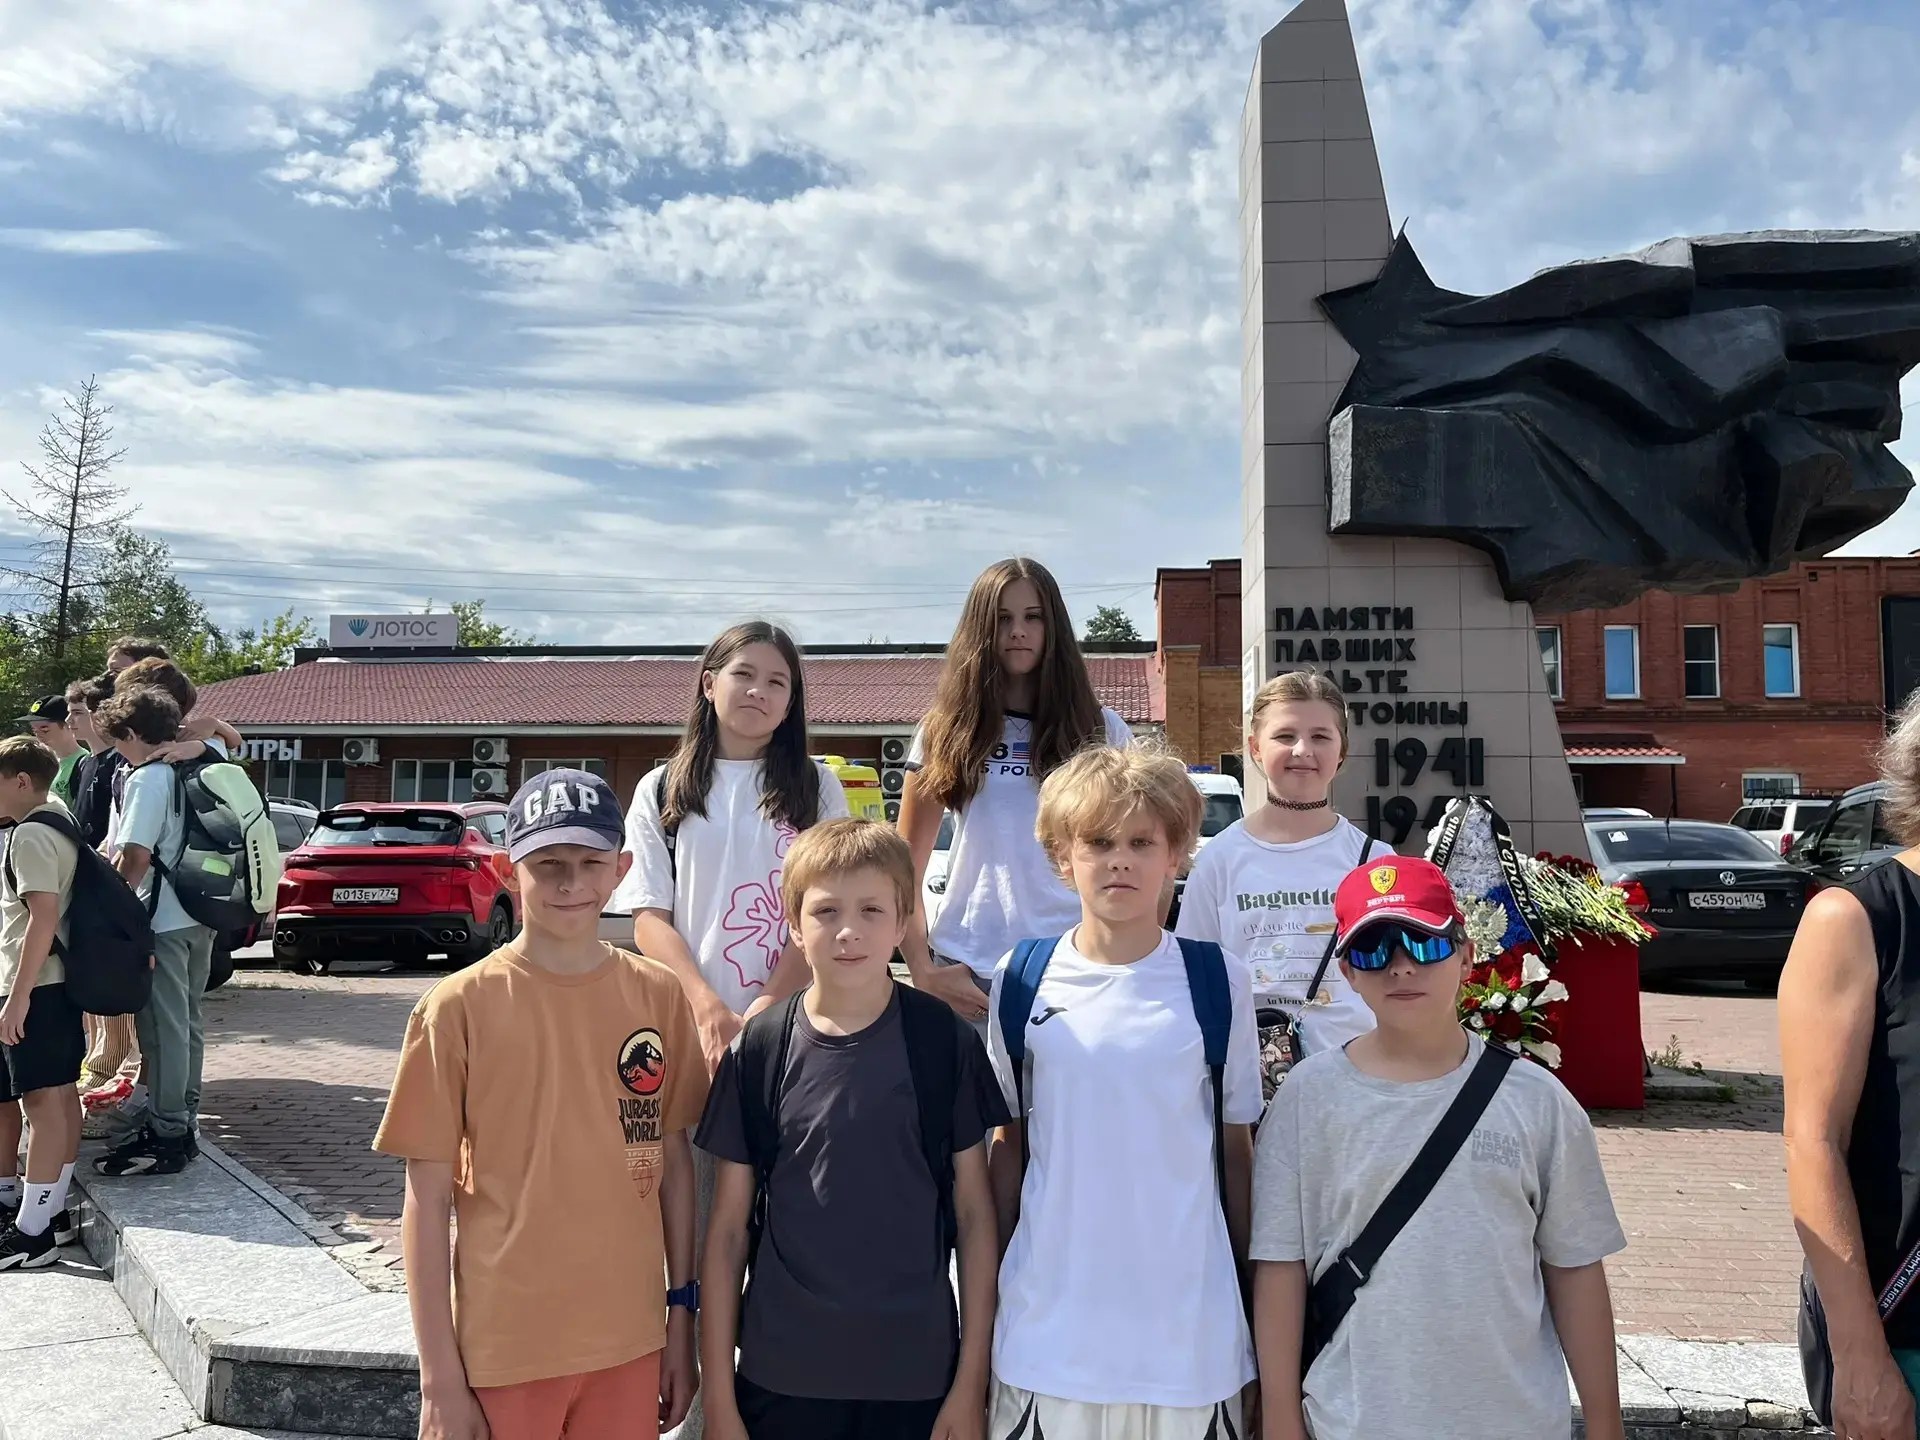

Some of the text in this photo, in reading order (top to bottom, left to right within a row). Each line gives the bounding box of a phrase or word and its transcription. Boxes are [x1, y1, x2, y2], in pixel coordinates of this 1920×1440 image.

[369, 620, 438, 639] ЛОТОС
[1275, 606, 1414, 632] ПАМЯТИ
[1275, 638, 1417, 663] ПАВШИХ
[1000, 765, 1033, 777] POL
[1374, 737, 1484, 787] 1941
[524, 782, 600, 825] GAP
[619, 1116, 662, 1144] WORL
